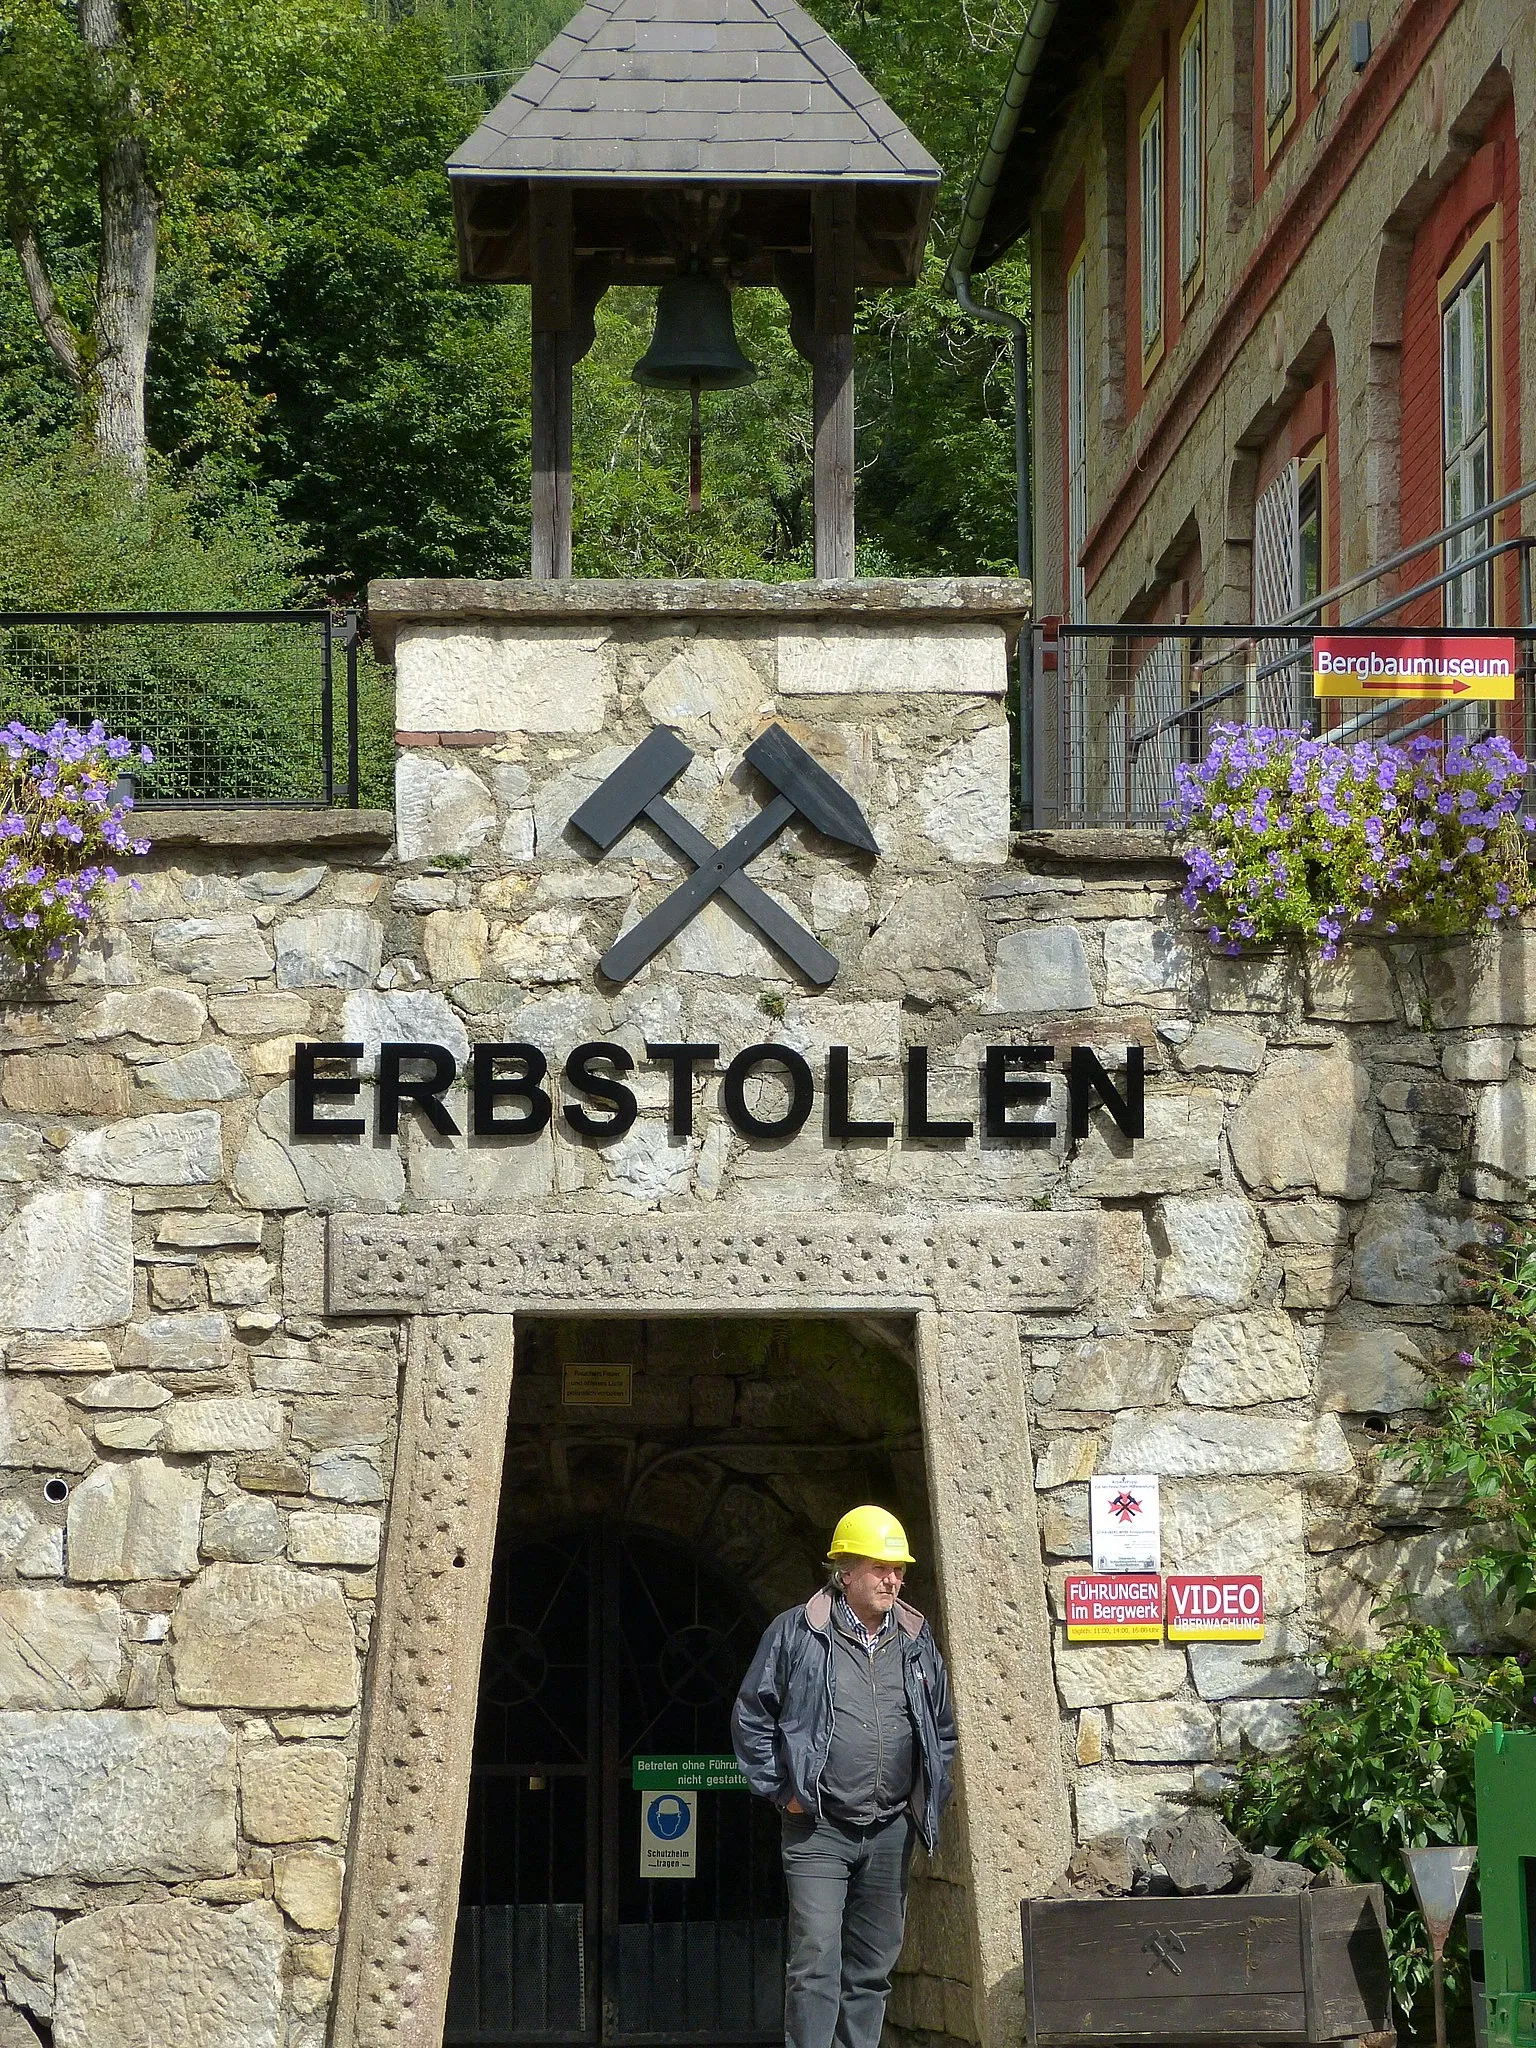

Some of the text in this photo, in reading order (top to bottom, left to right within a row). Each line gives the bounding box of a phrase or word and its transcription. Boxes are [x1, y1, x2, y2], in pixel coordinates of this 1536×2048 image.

[1317, 651, 1510, 681] Bergbaumuseum
[293, 1041, 1146, 1140] ERBSTOLLEN
[1070, 1581, 1159, 1601] FÜHRUNGEN
[1171, 1584, 1260, 1615] VIDEO
[1071, 1602, 1160, 1623] im Bergwerk
[1173, 1616, 1260, 1633] ÜBERWACHUNG
[637, 1759, 739, 1771] Betreten ohne Führun
[678, 1774, 748, 1786] nicht gestatte
[647, 1849, 690, 1858] Schutzhelm
[656, 1859, 680, 1868] tragen
